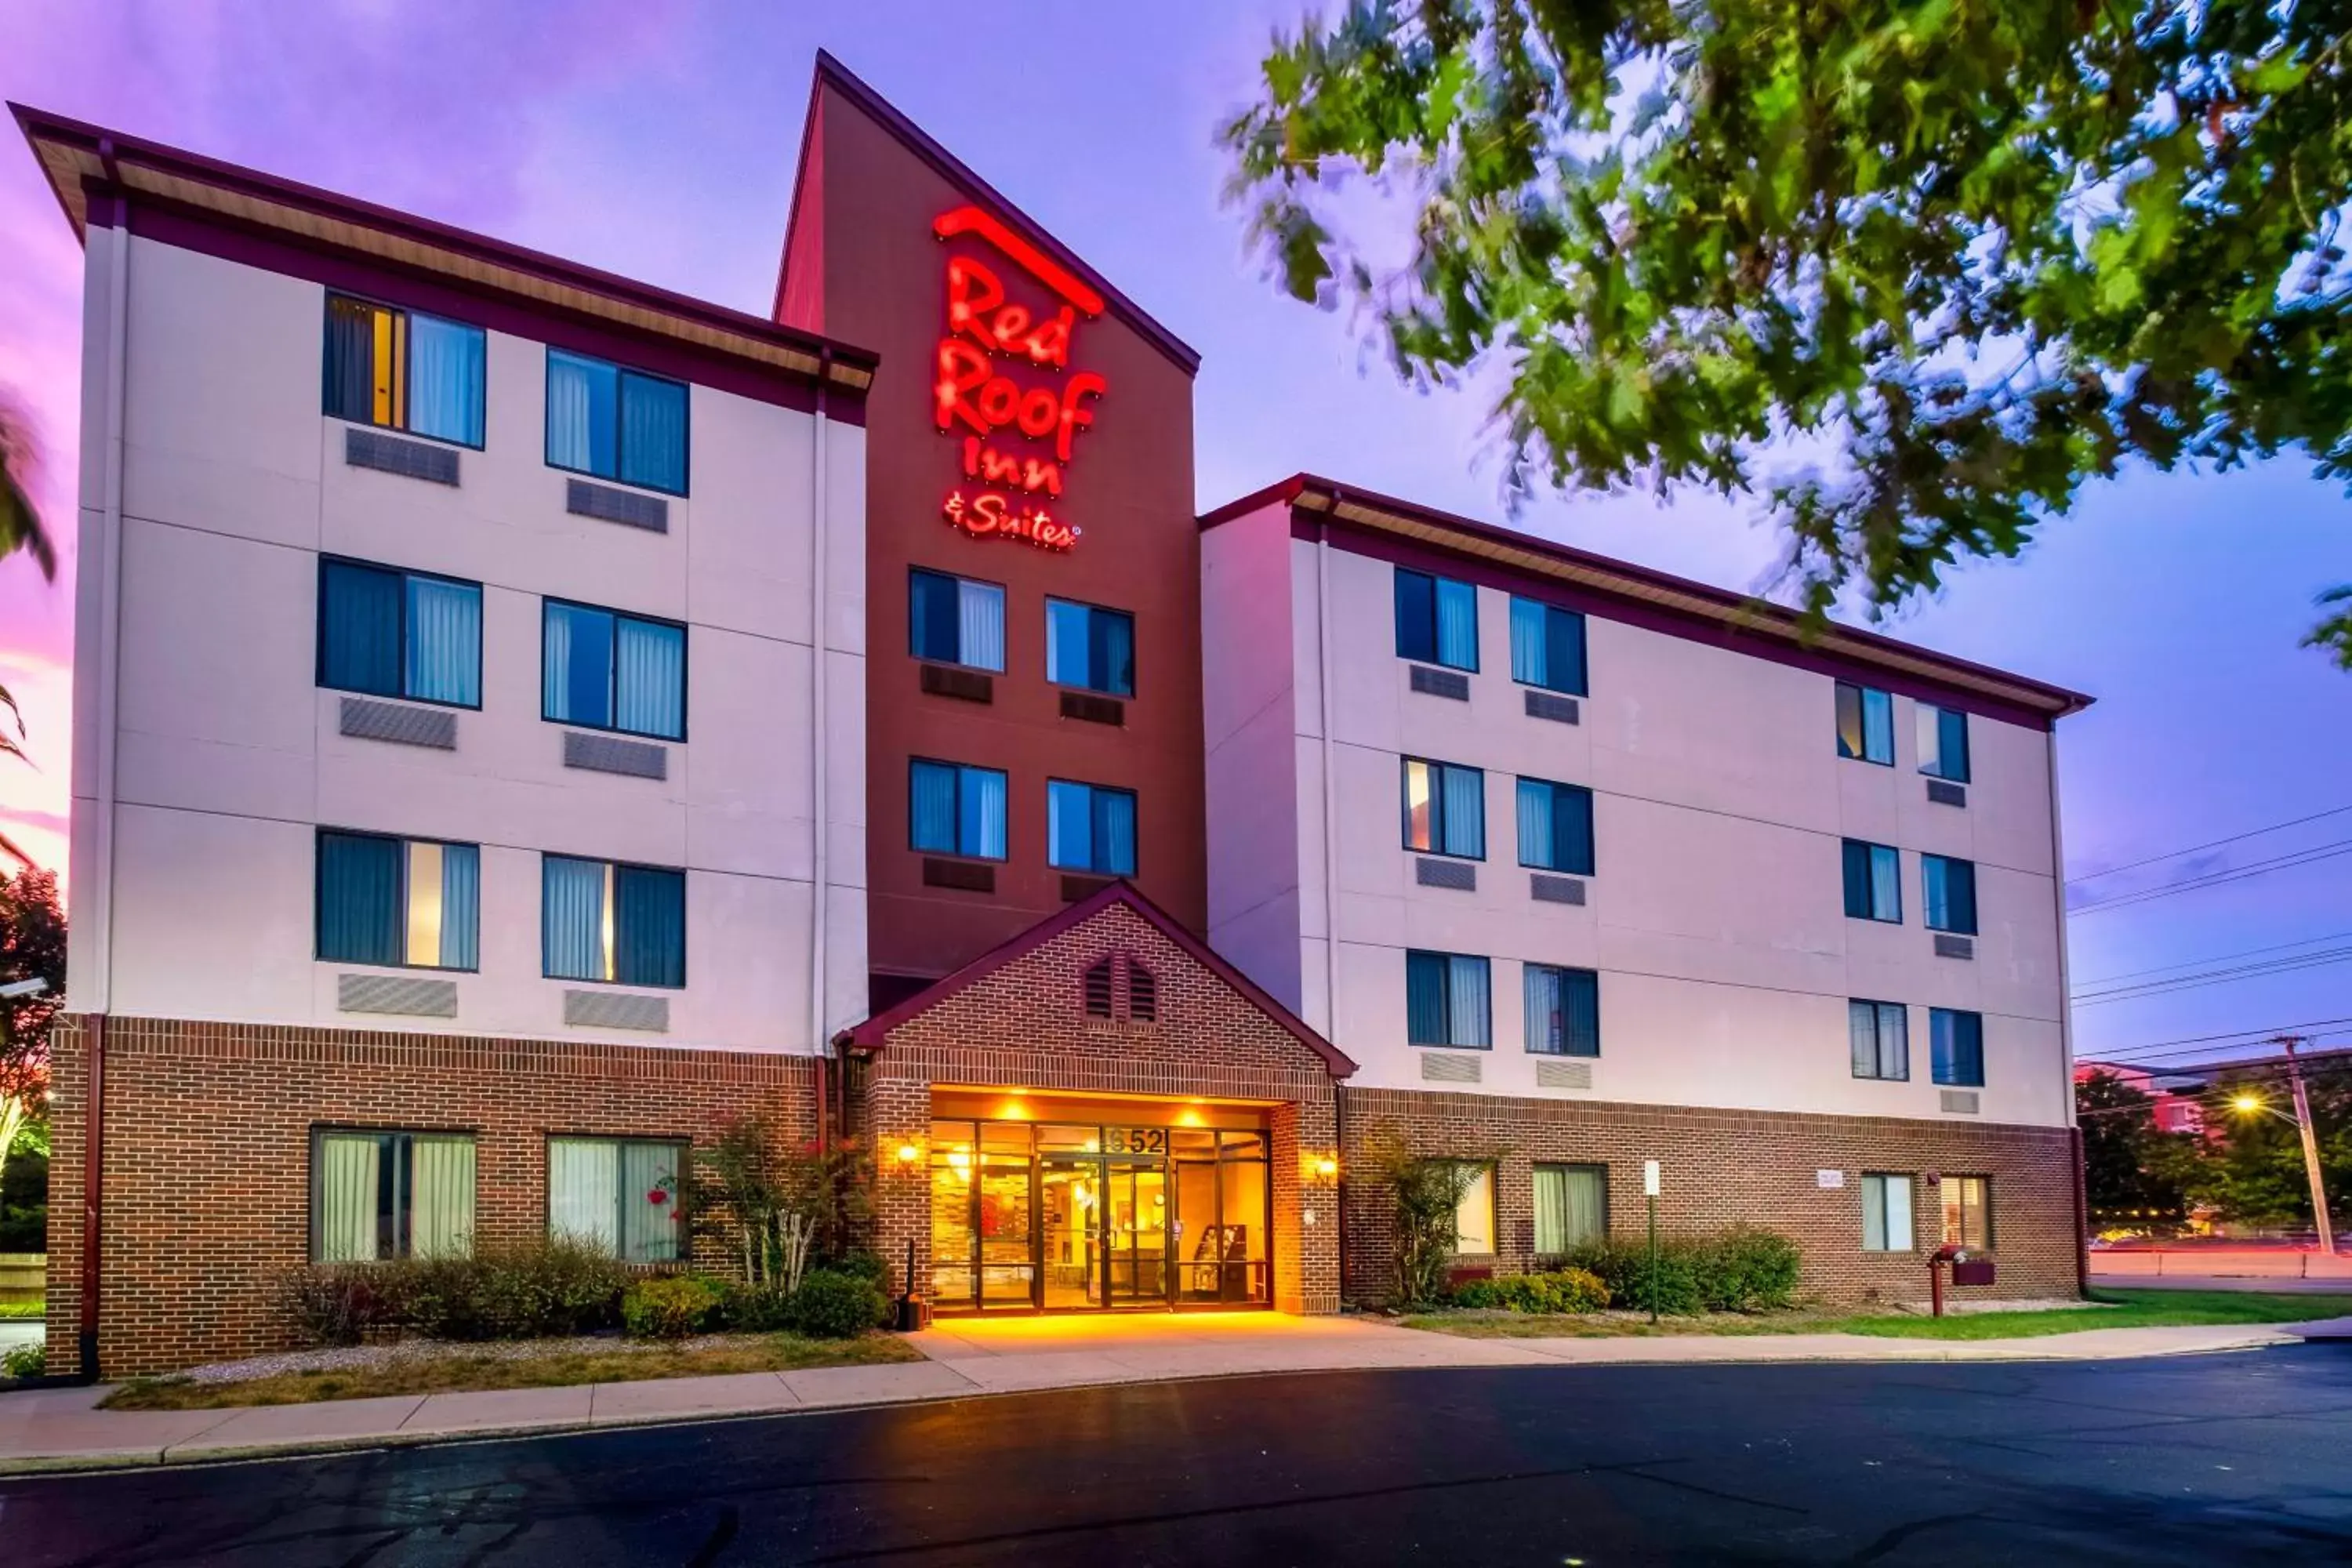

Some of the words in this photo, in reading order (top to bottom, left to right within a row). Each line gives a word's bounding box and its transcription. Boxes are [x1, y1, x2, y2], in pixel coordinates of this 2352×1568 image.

[950, 257, 1073, 366] Red
[938, 339, 1106, 461] Roof
[964, 436, 1062, 495] Inn
[945, 492, 965, 524] &
